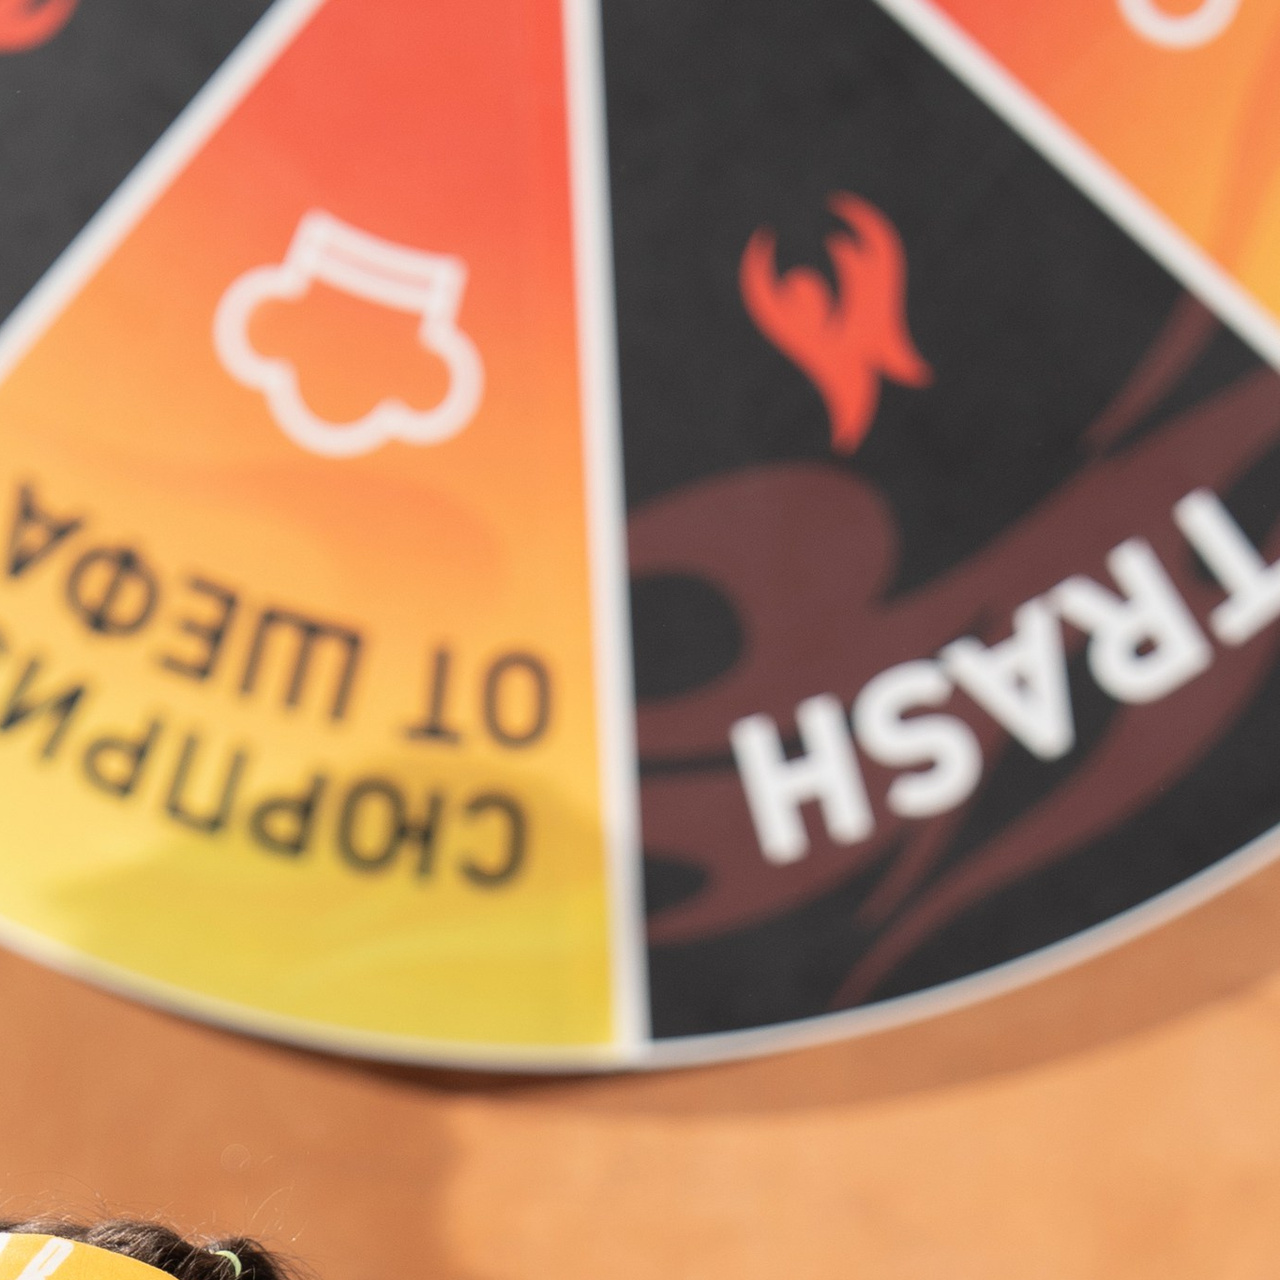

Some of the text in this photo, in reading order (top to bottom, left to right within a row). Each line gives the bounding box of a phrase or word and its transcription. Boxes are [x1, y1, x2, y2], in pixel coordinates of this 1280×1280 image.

[3, 476, 554, 749] ОТ ШЕФА
[730, 487, 1280, 866] TRASH
